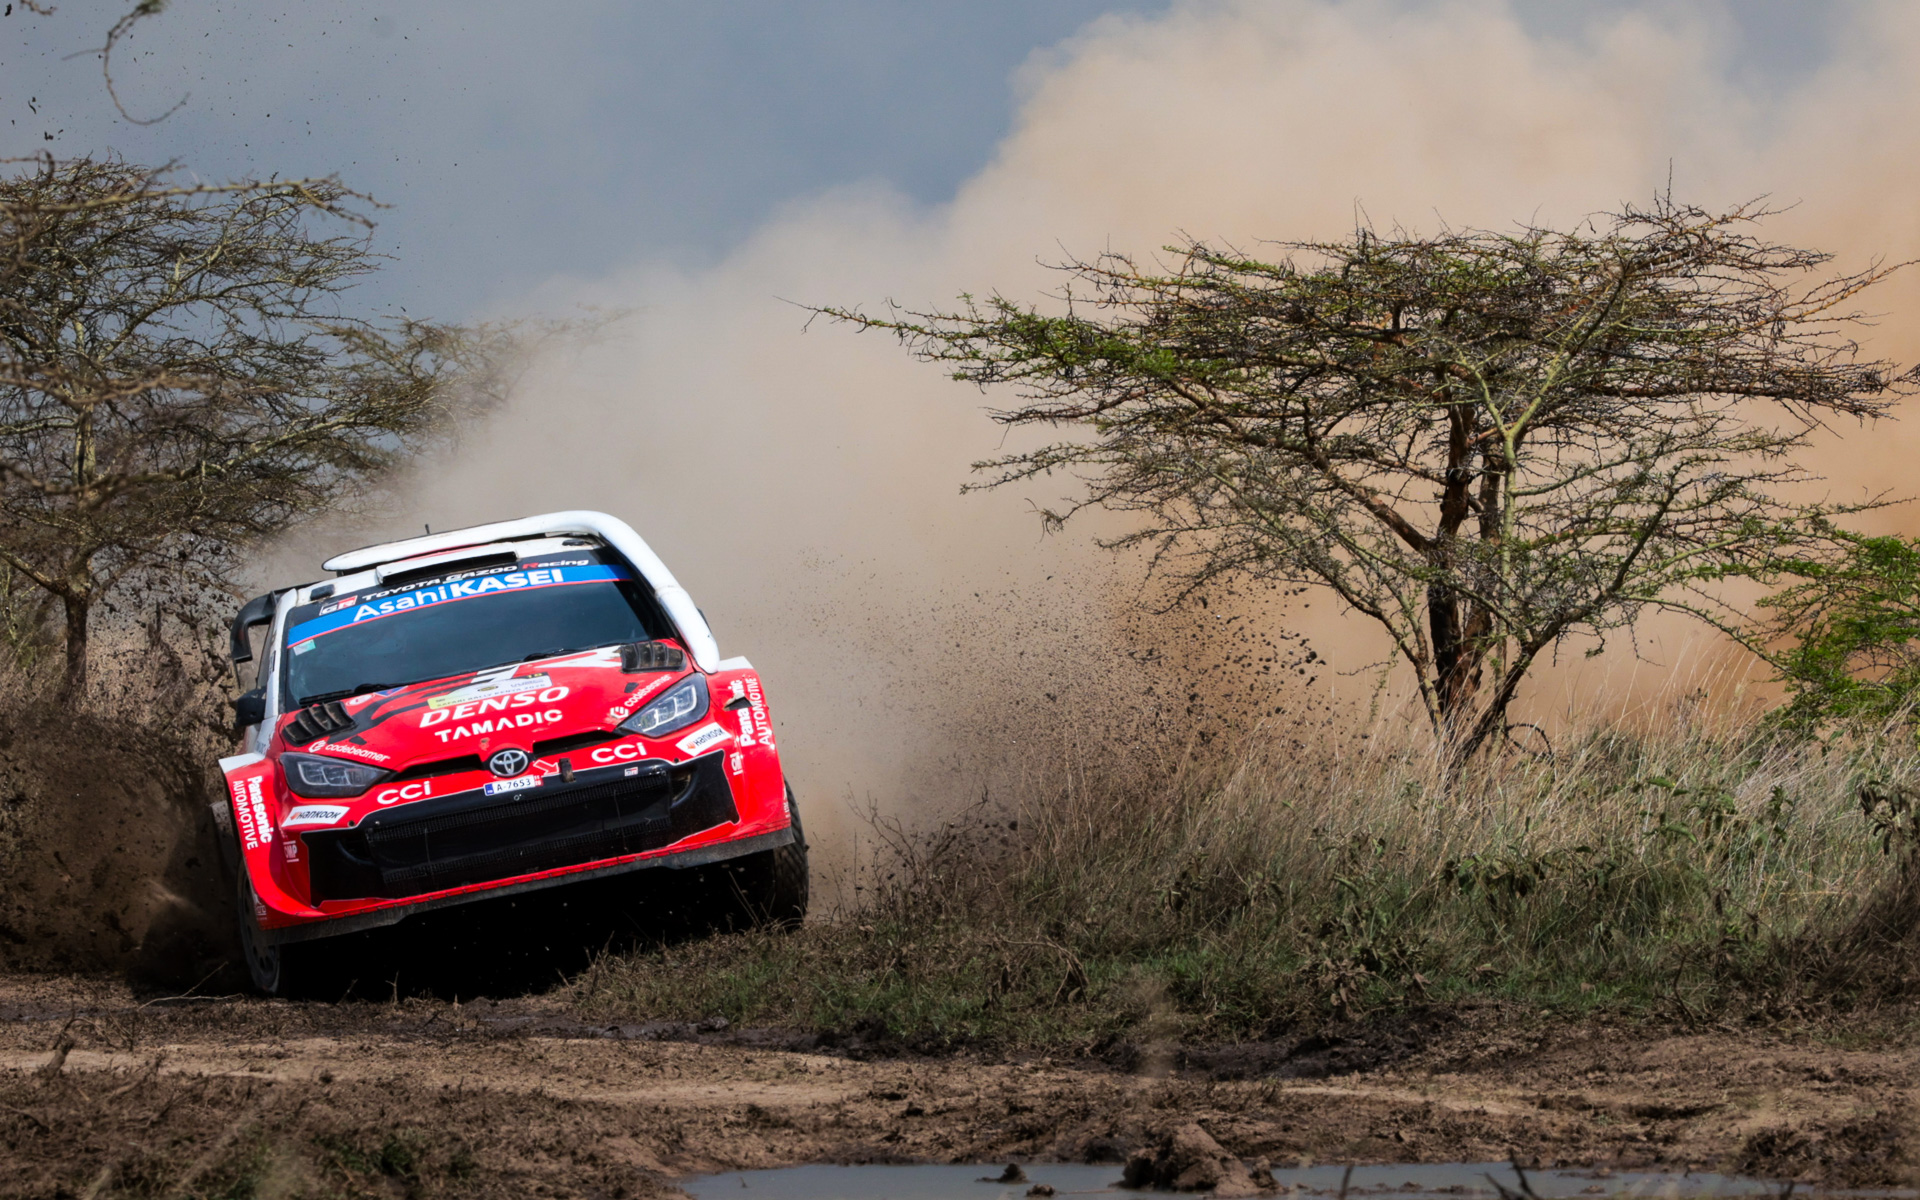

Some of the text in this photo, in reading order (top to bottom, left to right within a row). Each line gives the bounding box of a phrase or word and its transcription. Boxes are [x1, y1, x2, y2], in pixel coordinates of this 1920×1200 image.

[320, 559, 590, 615] GR TOYOTA GAZOO Racing
[419, 686, 570, 729] DENSO
[624, 673, 673, 707] codebeamer
[745, 677, 773, 746] AUTOMOTIVE
[435, 708, 563, 743] TAMADIC
[326, 743, 391, 764] codebeamer
[496, 777, 532, 792] A-7653
[232, 780, 259, 851] AUTOMOTIVE
[247, 775, 275, 844] Panasonic
